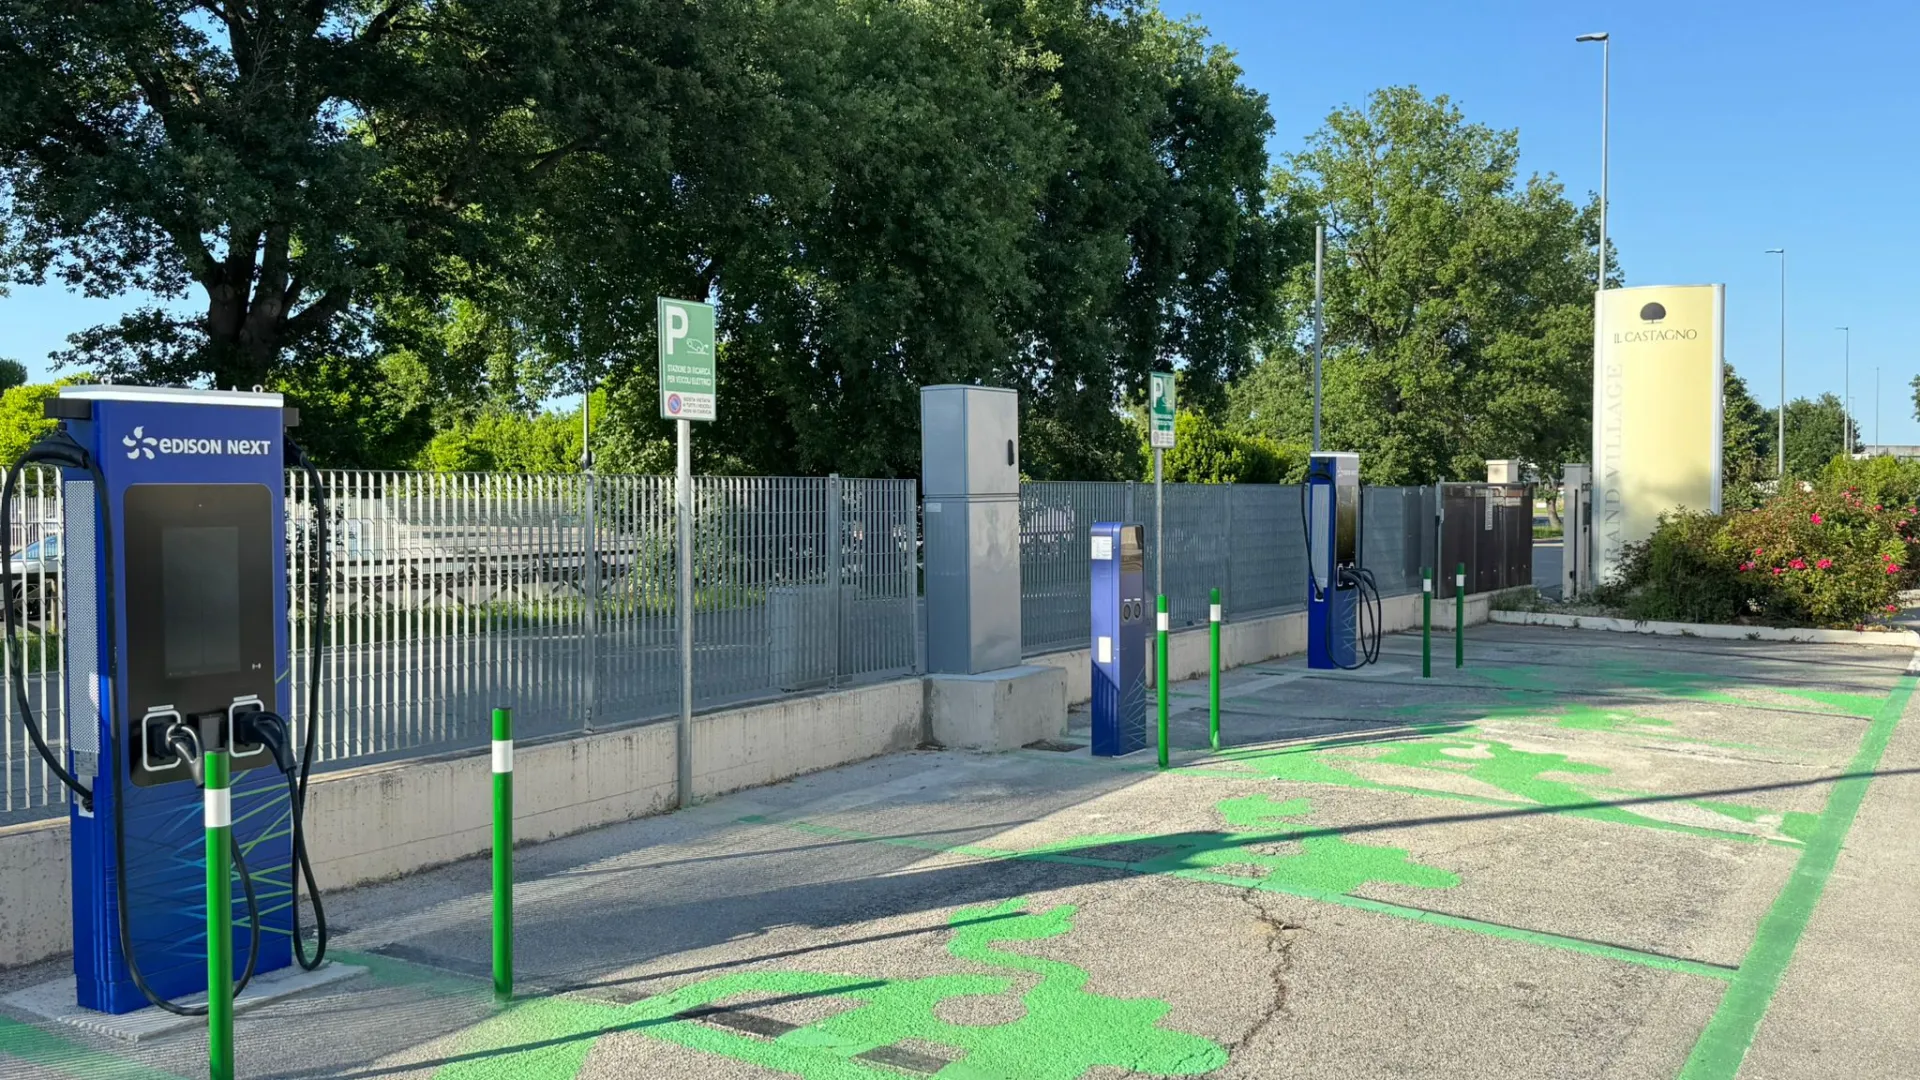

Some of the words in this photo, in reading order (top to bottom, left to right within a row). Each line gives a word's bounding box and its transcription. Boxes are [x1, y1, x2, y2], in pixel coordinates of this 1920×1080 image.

[665, 304, 689, 355] P
[1614, 333, 1622, 344] IL
[1624, 328, 1698, 343] CASTAGNO
[1153, 377, 1163, 408] P
[1605, 363, 1623, 479] VILLAGE
